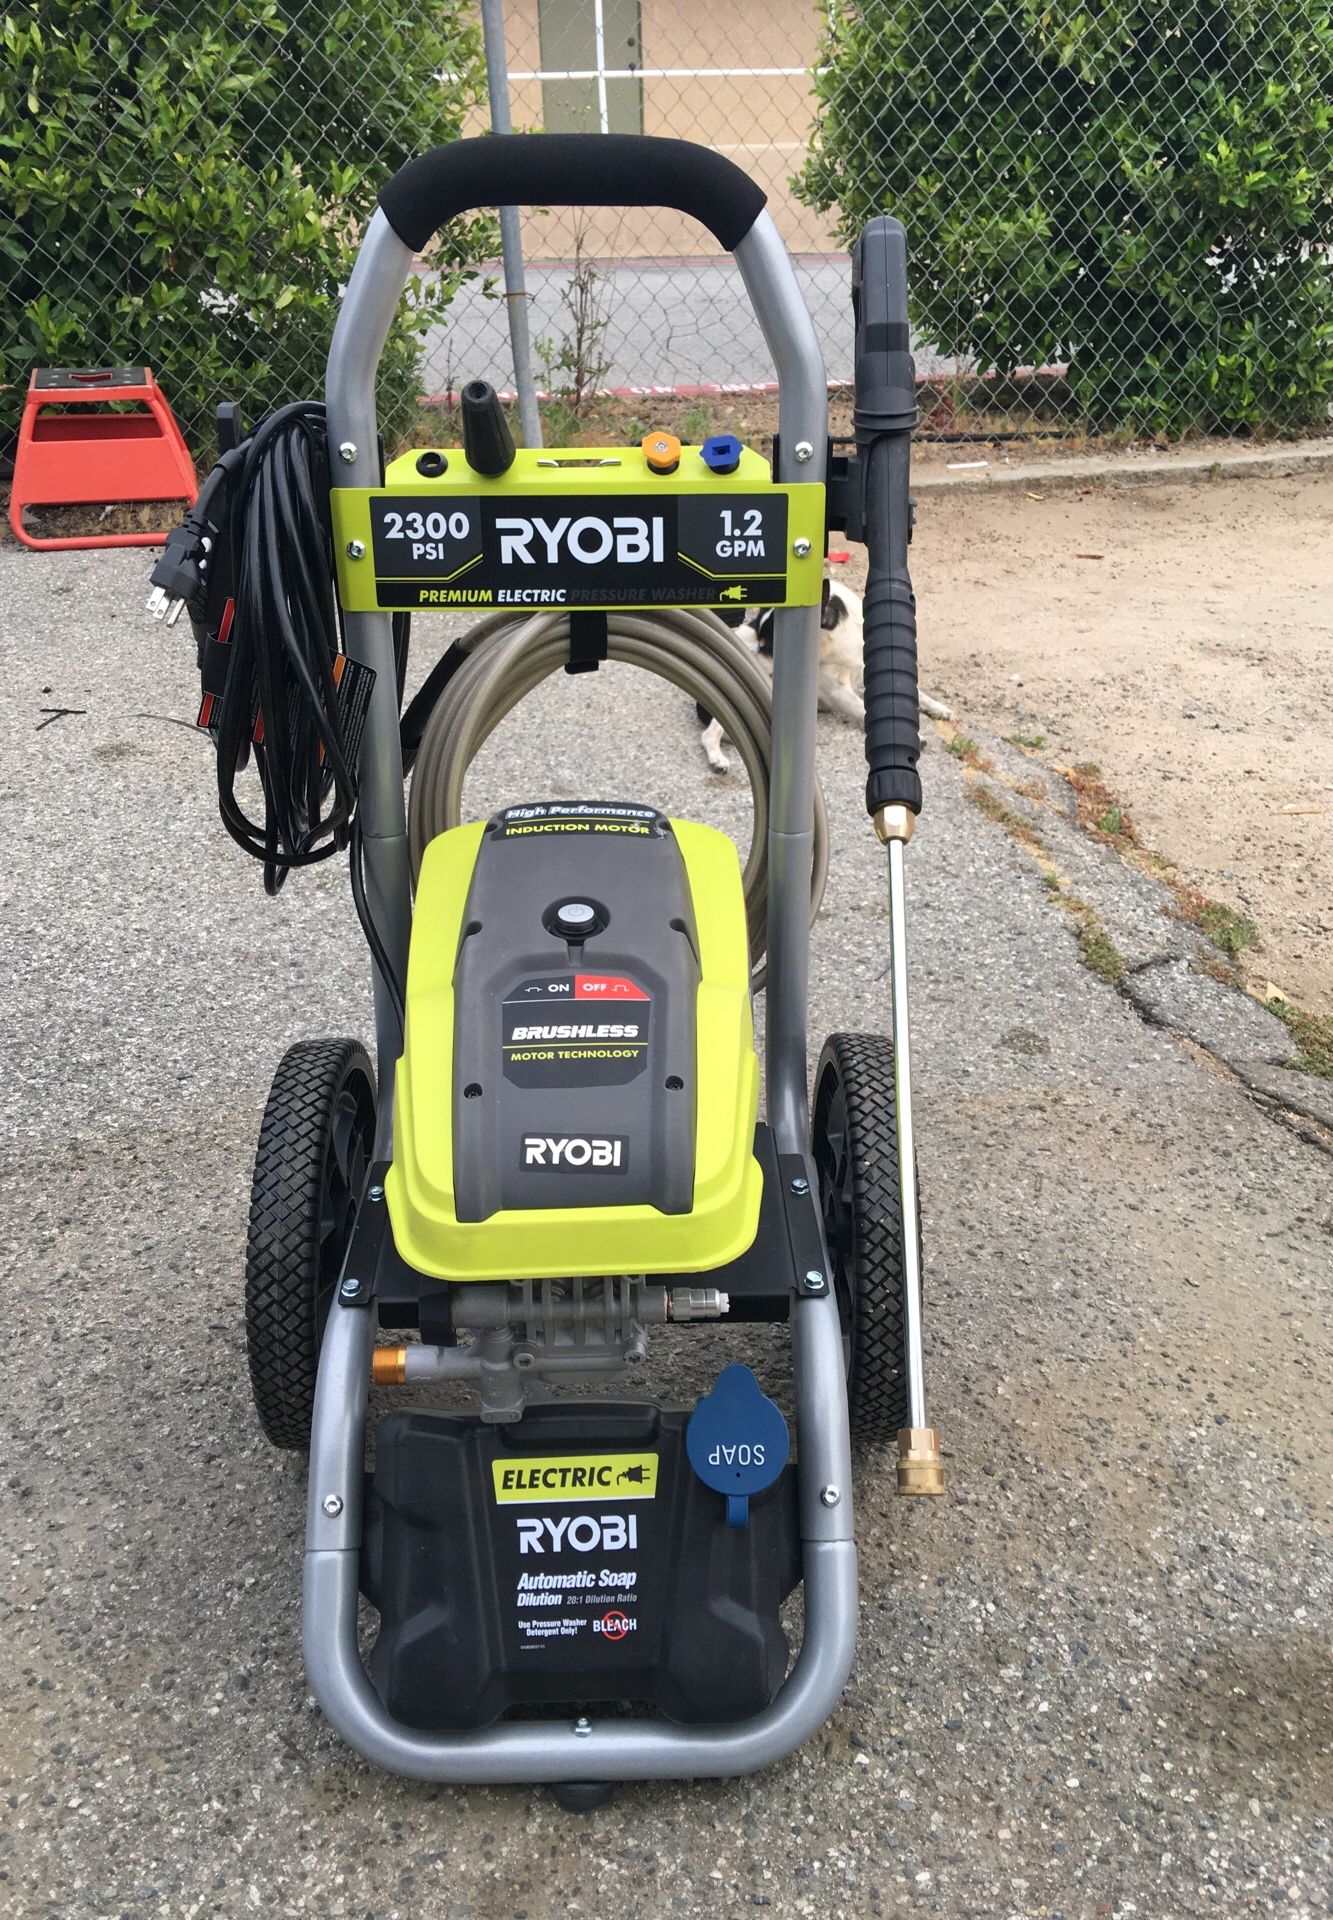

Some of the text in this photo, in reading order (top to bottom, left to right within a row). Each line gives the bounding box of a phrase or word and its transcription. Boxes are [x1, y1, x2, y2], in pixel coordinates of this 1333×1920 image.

[384, 511, 470, 540] 2300
[719, 509, 762, 537] 1.2
[495, 516, 664, 564] RYOBI
[715, 539, 766, 557] GPM
[412, 542, 444, 560] PSI
[419, 587, 716, 603] PREMIUM ELECTRIC PRESSURE WASHER
[505, 805, 656, 820] High Performance
[505, 823, 650, 836] INDUCTION MOTOR
[547, 983, 570, 993] ON
[582, 983, 607, 992] OFF
[511, 1024, 639, 1041] BRUSHLESS
[511, 1049, 640, 1062] MOTOR TECHNOLOGY
[524, 1137, 622, 1168] RYOBI
[708, 1444, 765, 1466] SOAP
[501, 1465, 613, 1490] ELECTRIC
[516, 1514, 638, 1554] RYOBI
[516, 1568, 637, 1591] Automatic Soap
[516, 1592, 638, 1607] Dilution 20:1 Dilution Ratio
[518, 1618, 588, 1629] Use Pressure Washer
[526, 1626, 578, 1638] Detergent Only!
[592, 1618, 637, 1632] BLEACH
